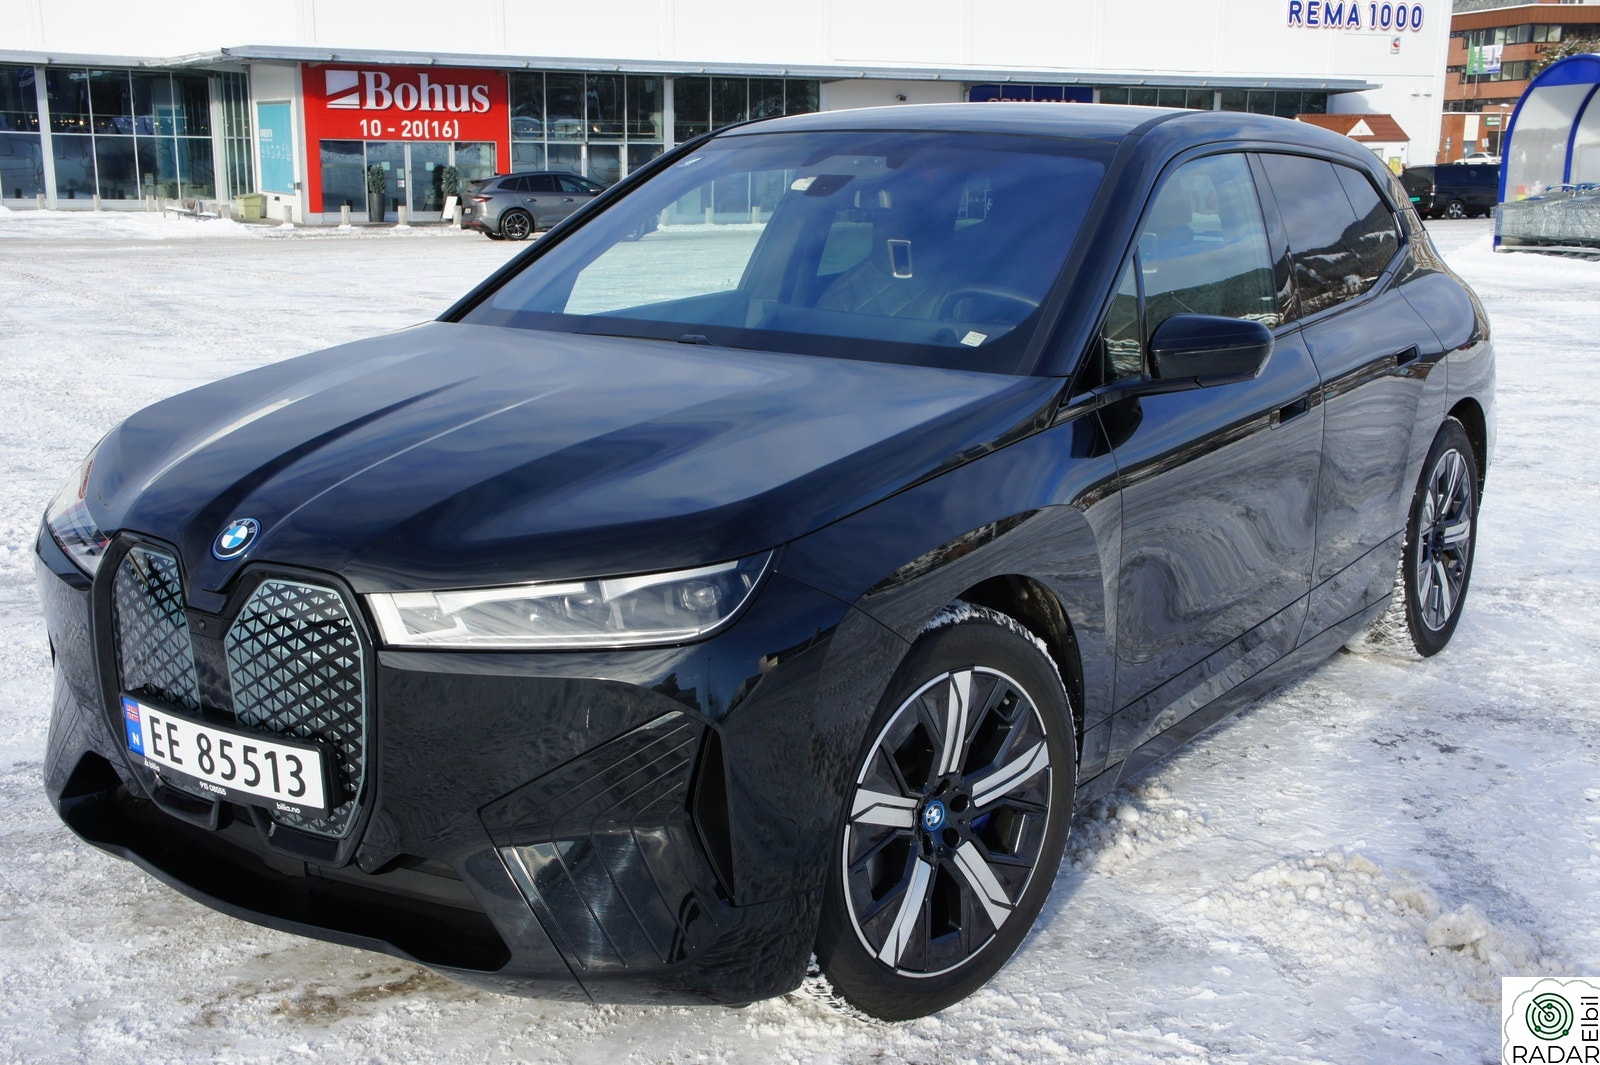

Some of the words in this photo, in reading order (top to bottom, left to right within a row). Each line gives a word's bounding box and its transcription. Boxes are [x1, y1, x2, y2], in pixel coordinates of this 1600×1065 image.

[1288, 0, 1361, 28] REMA
[1369, 2, 1424, 30] 1000
[361, 71, 490, 113] Bohus
[359, 119, 382, 137] 10
[401, 119, 459, 139] 20(16)
[132, 732, 140, 746] N
[149, 714, 183, 765] EE
[196, 732, 306, 797] 85513
